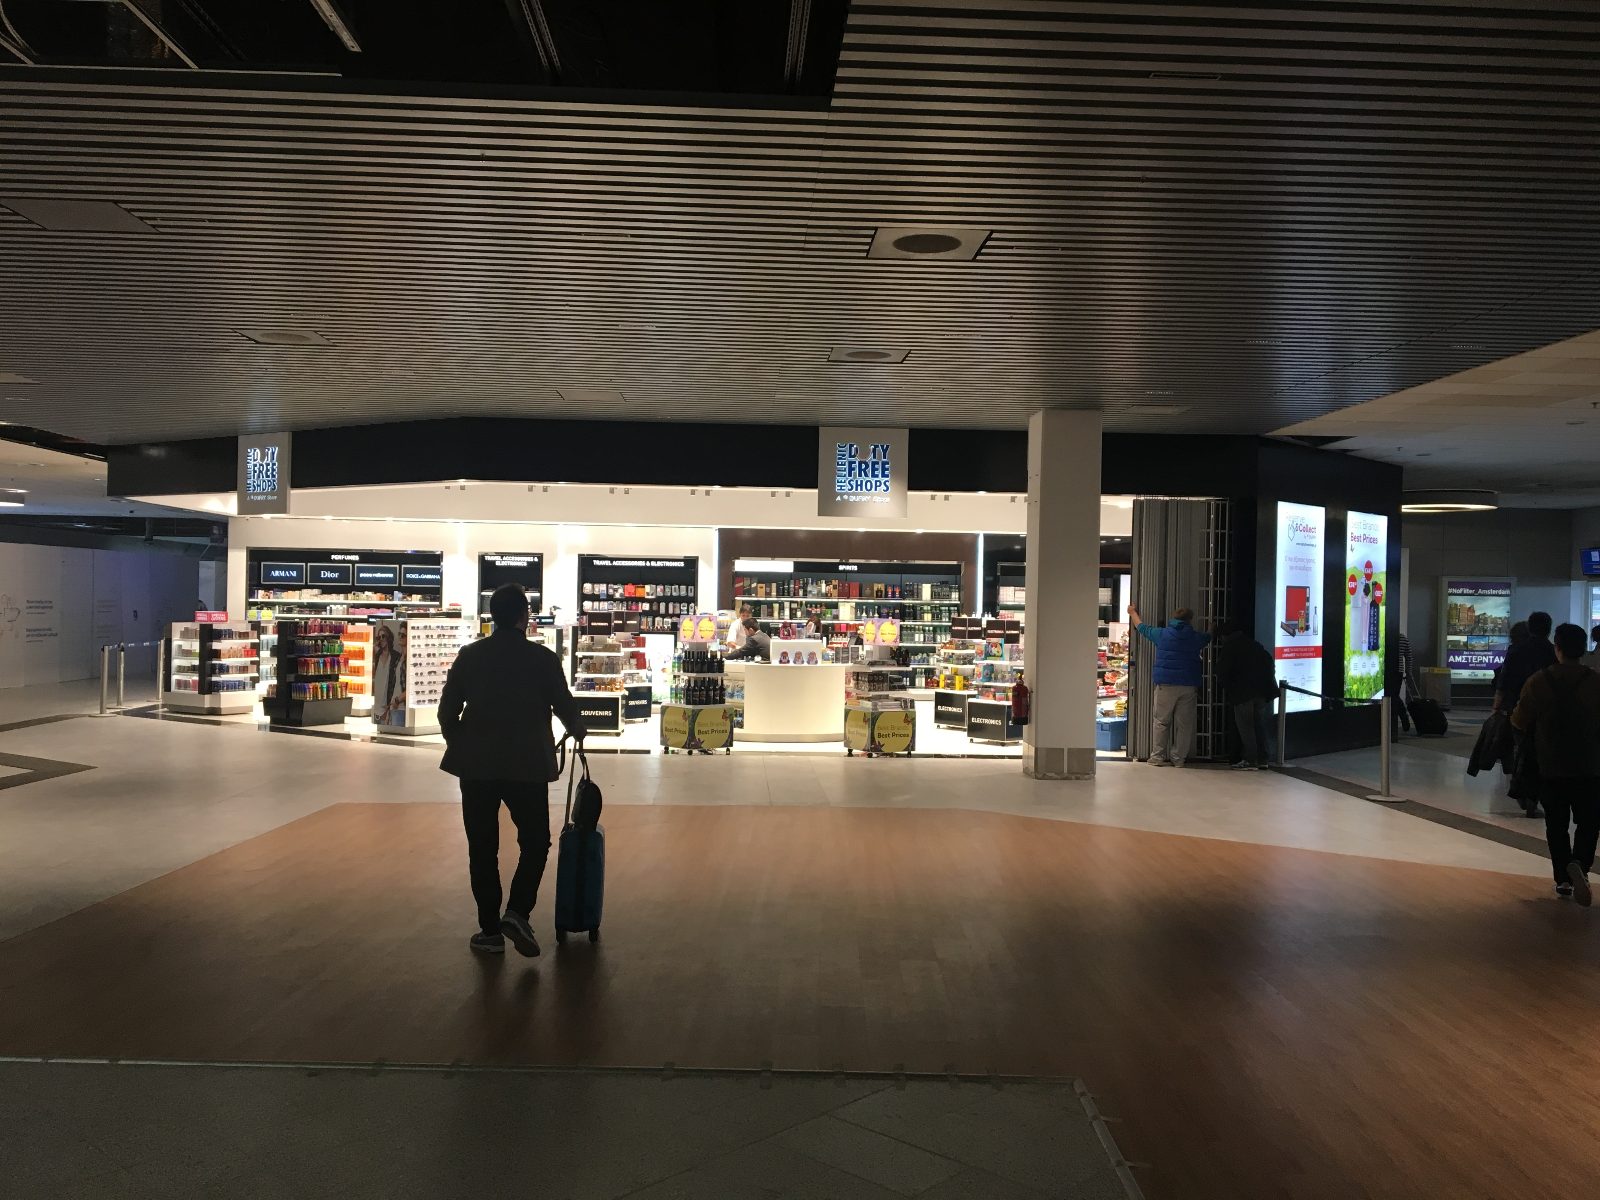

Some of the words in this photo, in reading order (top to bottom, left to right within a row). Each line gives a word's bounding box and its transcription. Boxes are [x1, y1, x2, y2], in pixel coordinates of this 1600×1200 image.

[253, 463, 278, 480] FREE
[836, 443, 847, 492] HELLENIC
[847, 460, 890, 479] FREE
[252, 479, 277, 493] SHOPS
[847, 479, 890, 494] SHOPS
[1351, 531, 1362, 542] Best
[1363, 533, 1378, 544] Prices
[320, 570, 339, 578] Dior
[937, 705, 963, 713] ELECTRONICS
[971, 716, 1002, 726] ELECTRONICS
